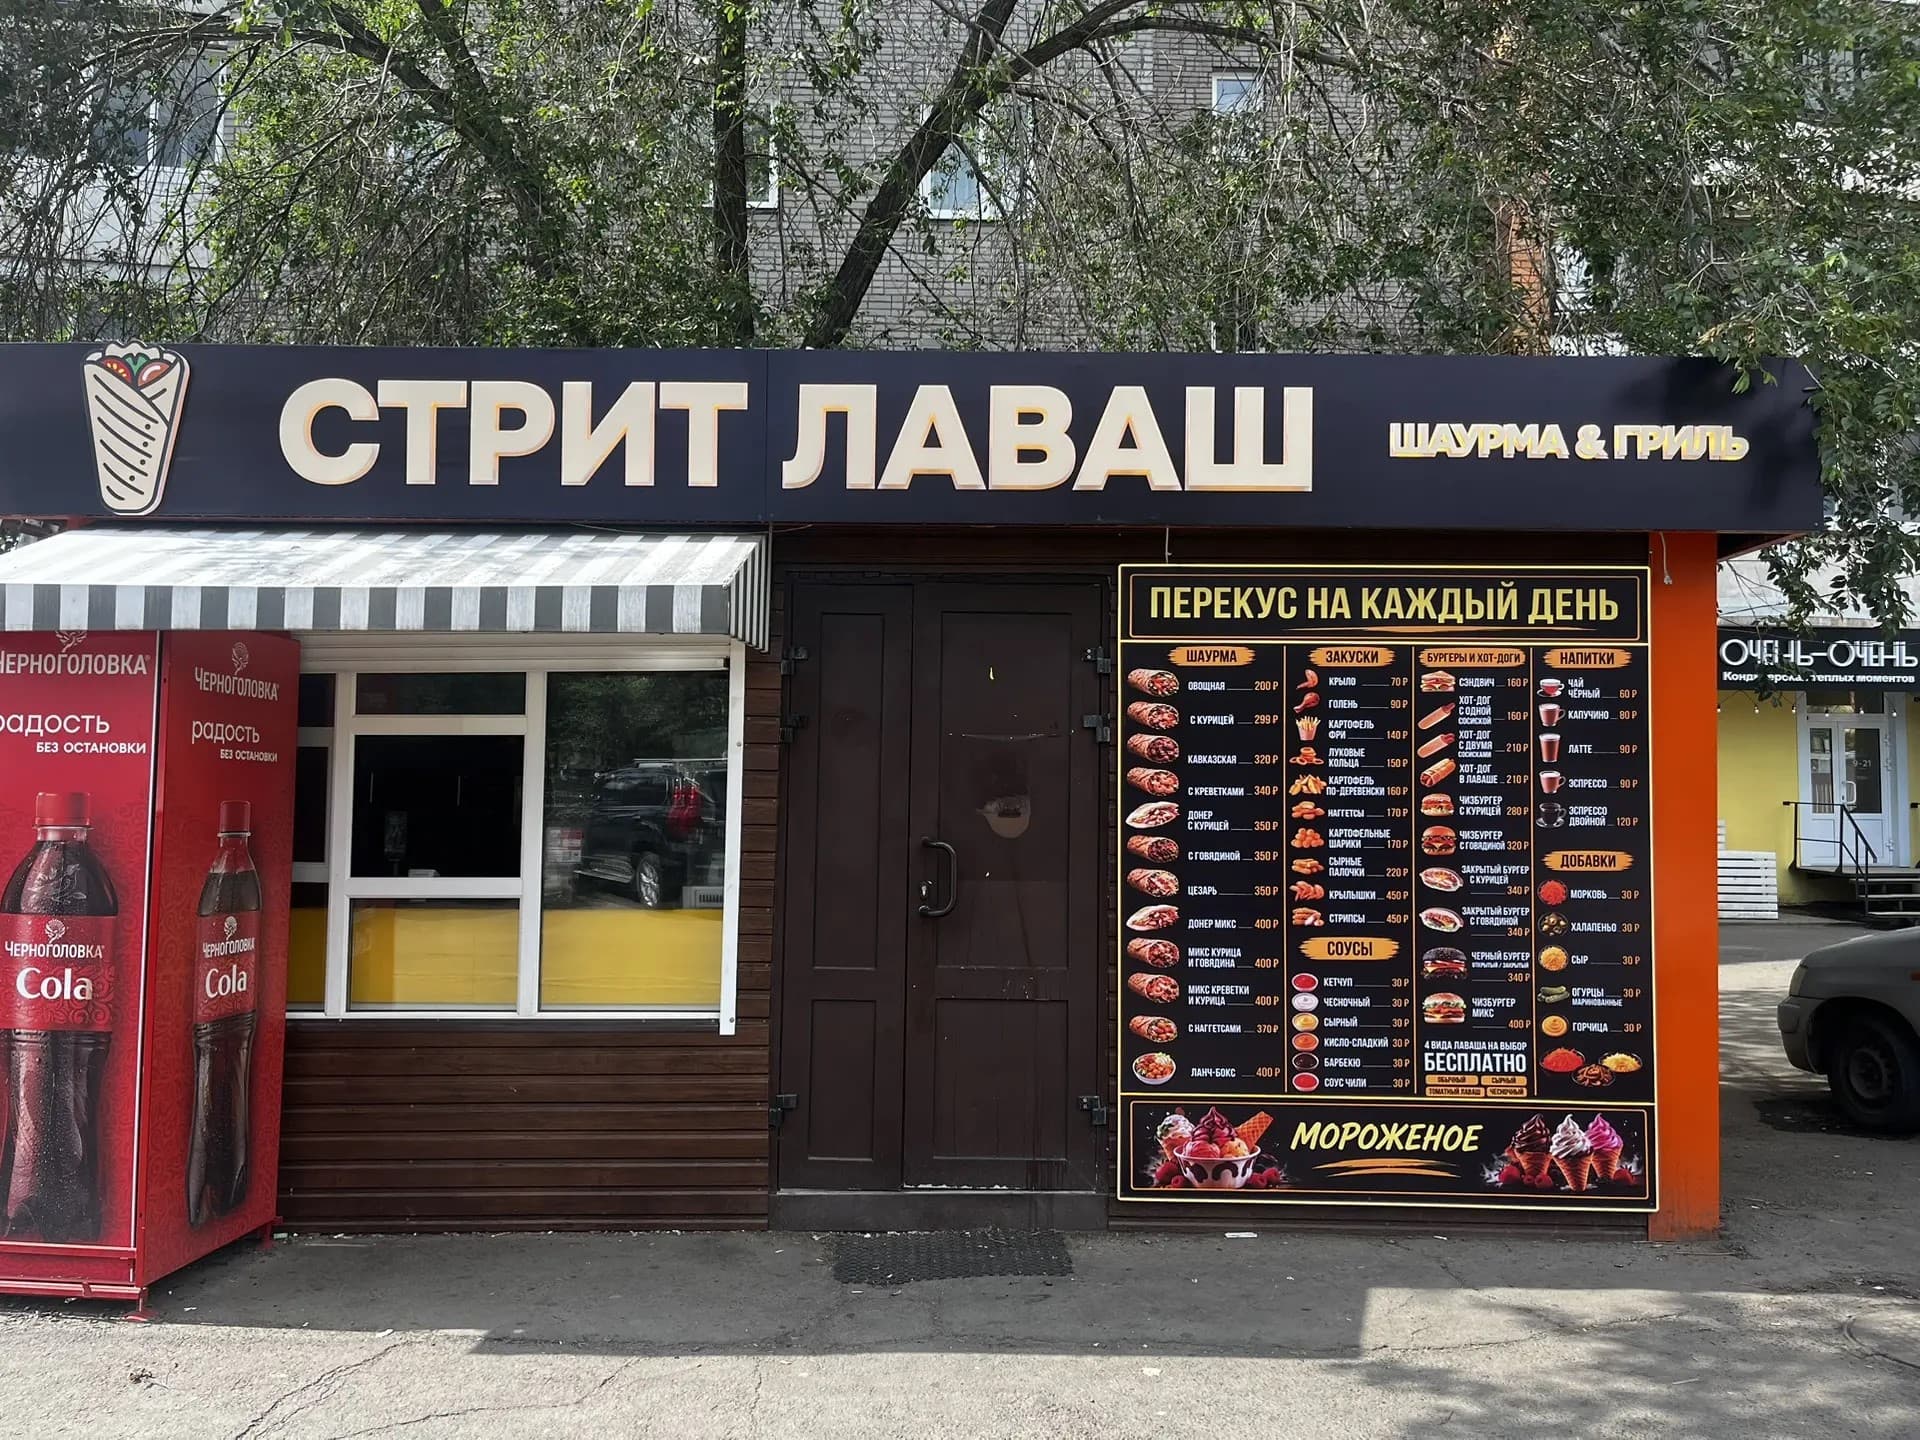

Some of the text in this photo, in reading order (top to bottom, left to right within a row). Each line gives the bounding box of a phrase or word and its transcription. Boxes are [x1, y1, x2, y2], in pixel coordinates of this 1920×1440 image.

[279, 378, 1313, 491] СТРИТ ЛАВАШ
[1390, 423, 1750, 460] ШАУРМА & ГРИЛЬ
[1150, 581, 1619, 624] ПЕРЕКУС НА КАЖДЫЙ ДЕНЬ
[1187, 650, 1237, 663] ШАУРМА
[1326, 651, 1378, 663] ЗАКУСКИ
[1427, 652, 1520, 663] БУРГЕРЫ И ХОТ-ДОГИ
[1560, 652, 1614, 665] НАПИТКИ
[1329, 678, 1356, 686] КРЫЛО
[1459, 678, 1522, 687] СЭНДВИЧ 160
[1568, 678, 1583, 688] ЧАЙ
[1856, 675, 1915, 683] моментов
[195, 667, 278, 701] ЧЕРНОГОЛОВКА
[1188, 681, 1271, 691] ОВОЩНАЯ 200
[1620, 690, 1629, 698] 60
[1329, 700, 1358, 708] ГОЛЕНЬ
[1459, 696, 1491, 705] ХОТ-ДОГ
[1466, 706, 1491, 716] ОДНОЙ
[1568, 711, 1609, 720] КАПУЧИНО
[1197, 714, 1234, 724] КУРИЦЕЙ
[1255, 715, 1271, 724] 299
[1329, 720, 1374, 729] КАРТОФЕЛЬ
[192, 721, 260, 744] радость
[1329, 731, 1401, 740] ФРИ 140
[1459, 731, 1491, 740] ХОТ-ДОГ
[36, 742, 146, 754] БЕЗ ОСТАНОВКИ
[1466, 741, 1492, 750] ДВУМЯ
[1568, 745, 1592, 754] ЛАТТЕ
[220, 749, 277, 762] БЕЗ ОСТАНОВКИ
[1329, 748, 1365, 757] ЛУКОВЫЕ
[1188, 755, 1271, 764] КАВКАЗСКАЯ 320
[1329, 759, 1359, 768] КОЛЬЦА
[1459, 765, 1491, 774] ХОТ-ДОГ
[1329, 776, 1374, 785] КАРТОФЕЛЬ
[1466, 775, 1498, 783] ЛАВАШЕ
[1569, 779, 1607, 788] ЭСПРЕССО
[1195, 788, 1244, 796] КРЕВЕТКАМИ
[1255, 786, 1271, 795] 340
[1326, 787, 1401, 796] ПО-ДЕРЕВЕНСКИ 160
[1459, 796, 1502, 805] ЧИЗБУРГЕР
[1188, 811, 1213, 820] ДОНЕР
[1328, 809, 1364, 818] НАГГЕТСЫ
[1466, 806, 1501, 816] КУРИЦЕЙ
[1506, 807, 1522, 815] 280
[1569, 807, 1607, 816] ЭСПРЕССО
[1195, 820, 1229, 831] КУРИЦЕЙ
[1569, 816, 1630, 827] ДВОЙНОЙ 120
[1329, 830, 1390, 838] КАРТОФЕЛЬНЫЕ
[1459, 831, 1503, 840] ЧИЗБУРГЕР
[1329, 840, 1401, 849] ШАРИКИ 170
[1466, 841, 1505, 851] ГОВЯДИНОЙ
[1507, 841, 1522, 850] 320
[1195, 850, 1240, 861] ГОВЯДИНОЙ
[1329, 857, 1362, 866] СЫРНЫЕ
[1561, 855, 1616, 868] ДОБАВКИ
[1329, 868, 1401, 877] ПАЛОЧКИ 220
[1462, 865, 1529, 875] ЗАКРЫТЫЙ БУРГЕР
[1476, 874, 1508, 885] КУРИЦЕЙ
[1188, 886, 1271, 896] ЦЕЗАРЬ 350
[1329, 891, 1401, 900] КРЫЛЫШКИ 450
[1571, 890, 1632, 899] МОРКОВЬ 30
[1462, 906, 1529, 916] ЗАКРЫТЫЙ БУРГЕР
[1329, 914, 1365, 923] СТРИПСЫ
[1477, 916, 1518, 926] ГОВЯДИНОЙ
[1188, 920, 1237, 929] ДОНЕР МИКС
[1571, 923, 1617, 932] ХАЛАПЕНЬО
[5, 941, 102, 958] ЧЕРНОГОЛОВКА
[203, 937, 255, 958] ЧЕРНОГОЛОВКА
[1328, 942, 1372, 956] СОУСЫ
[1188, 948, 1241, 958] МИКС КУРИЦА
[1472, 951, 1530, 961] ЧЕРНЫЙ БУРГЕР
[1195, 959, 1235, 968] ГОВЯДИНА
[1571, 955, 1588, 964] СЫР
[206, 964, 247, 998] Cola
[1508, 973, 1522, 982] 340
[16, 967, 92, 1000] Cola
[1324, 978, 1402, 987] КЕТЧУП 30
[1188, 986, 1249, 995] МИКС КРЕВЕТКИ
[1572, 988, 1604, 998] ОГУРЦЫ
[1195, 997, 1225, 1006] КУРИЦА
[1324, 997, 1370, 1007] ЧЕСНОЧНЫЙ
[1472, 998, 1515, 1007] ЧИЗБУРГЕР
[1572, 998, 1622, 1007] МАРИНОВАННЫЕ
[1472, 1009, 1494, 1018] МИКС
[1324, 1017, 1357, 1027] СЫРНЫЙ
[1195, 1025, 1241, 1033] НАГГЕТСАМИ
[1257, 1025, 1272, 1033] 370
[1573, 1023, 1608, 1033] ГОРЧИЦА
[1324, 1037, 1388, 1048] КИСЛО-СЛАДКИЙ
[1431, 1041, 1452, 1050] ВИДА
[1454, 1041, 1486, 1050] ЛАВАША
[1488, 1042, 1498, 1050] НА
[1500, 1042, 1527, 1050] ВЫБОР
[1324, 1058, 1360, 1067] БАРБЕКЮ
[1424, 1053, 1526, 1072] БЕСПЛАТНО
[1191, 1068, 1236, 1077] ЛАНЧ-БОКС
[1324, 1079, 1366, 1088] СОУС ЧИЛИ
[1290, 1121, 1483, 1152] МОРОЖЕНОЕ
